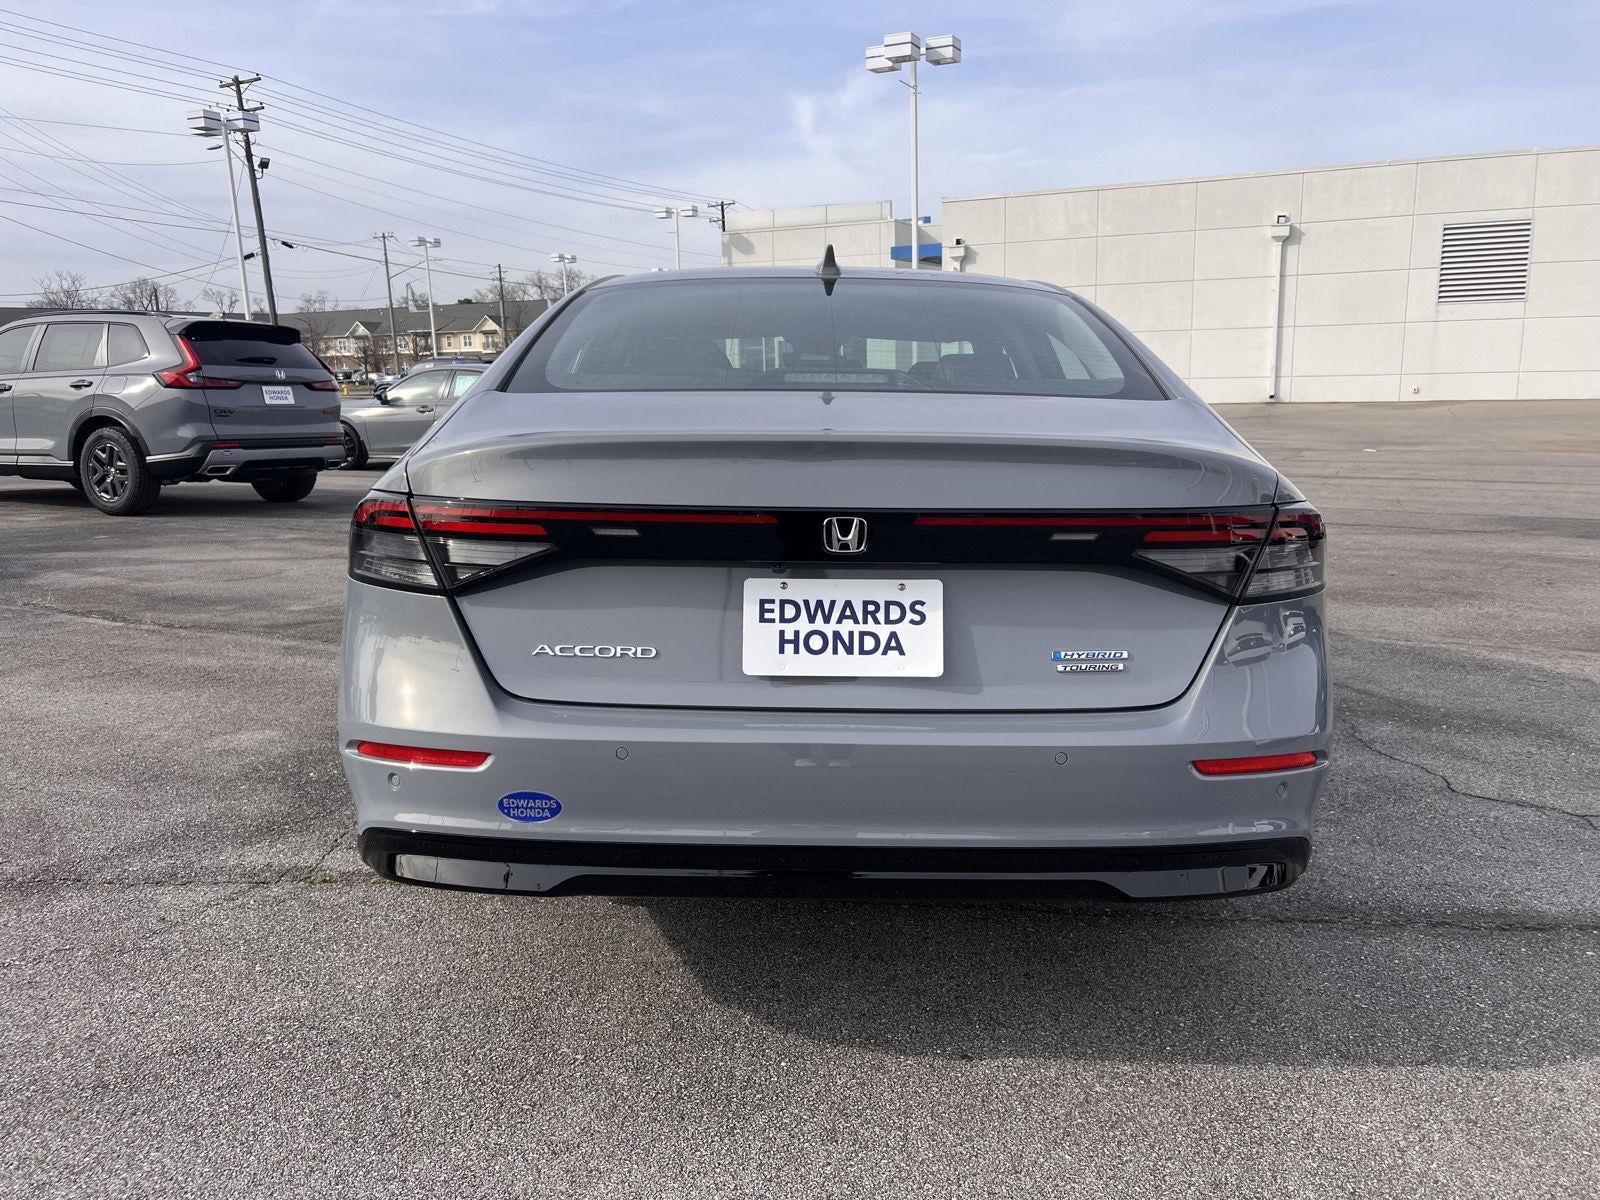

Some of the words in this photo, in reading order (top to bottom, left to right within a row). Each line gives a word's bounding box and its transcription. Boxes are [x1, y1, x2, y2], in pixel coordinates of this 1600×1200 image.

[758, 598, 927, 626] EDWARDS
[778, 629, 906, 656] HONDA
[532, 644, 657, 658] ACCORD
[1062, 651, 1125, 660] HYBRID
[1060, 663, 1120, 672] TOURING
[503, 798, 557, 809] EDWARDS
[510, 808, 551, 818] HONDA
